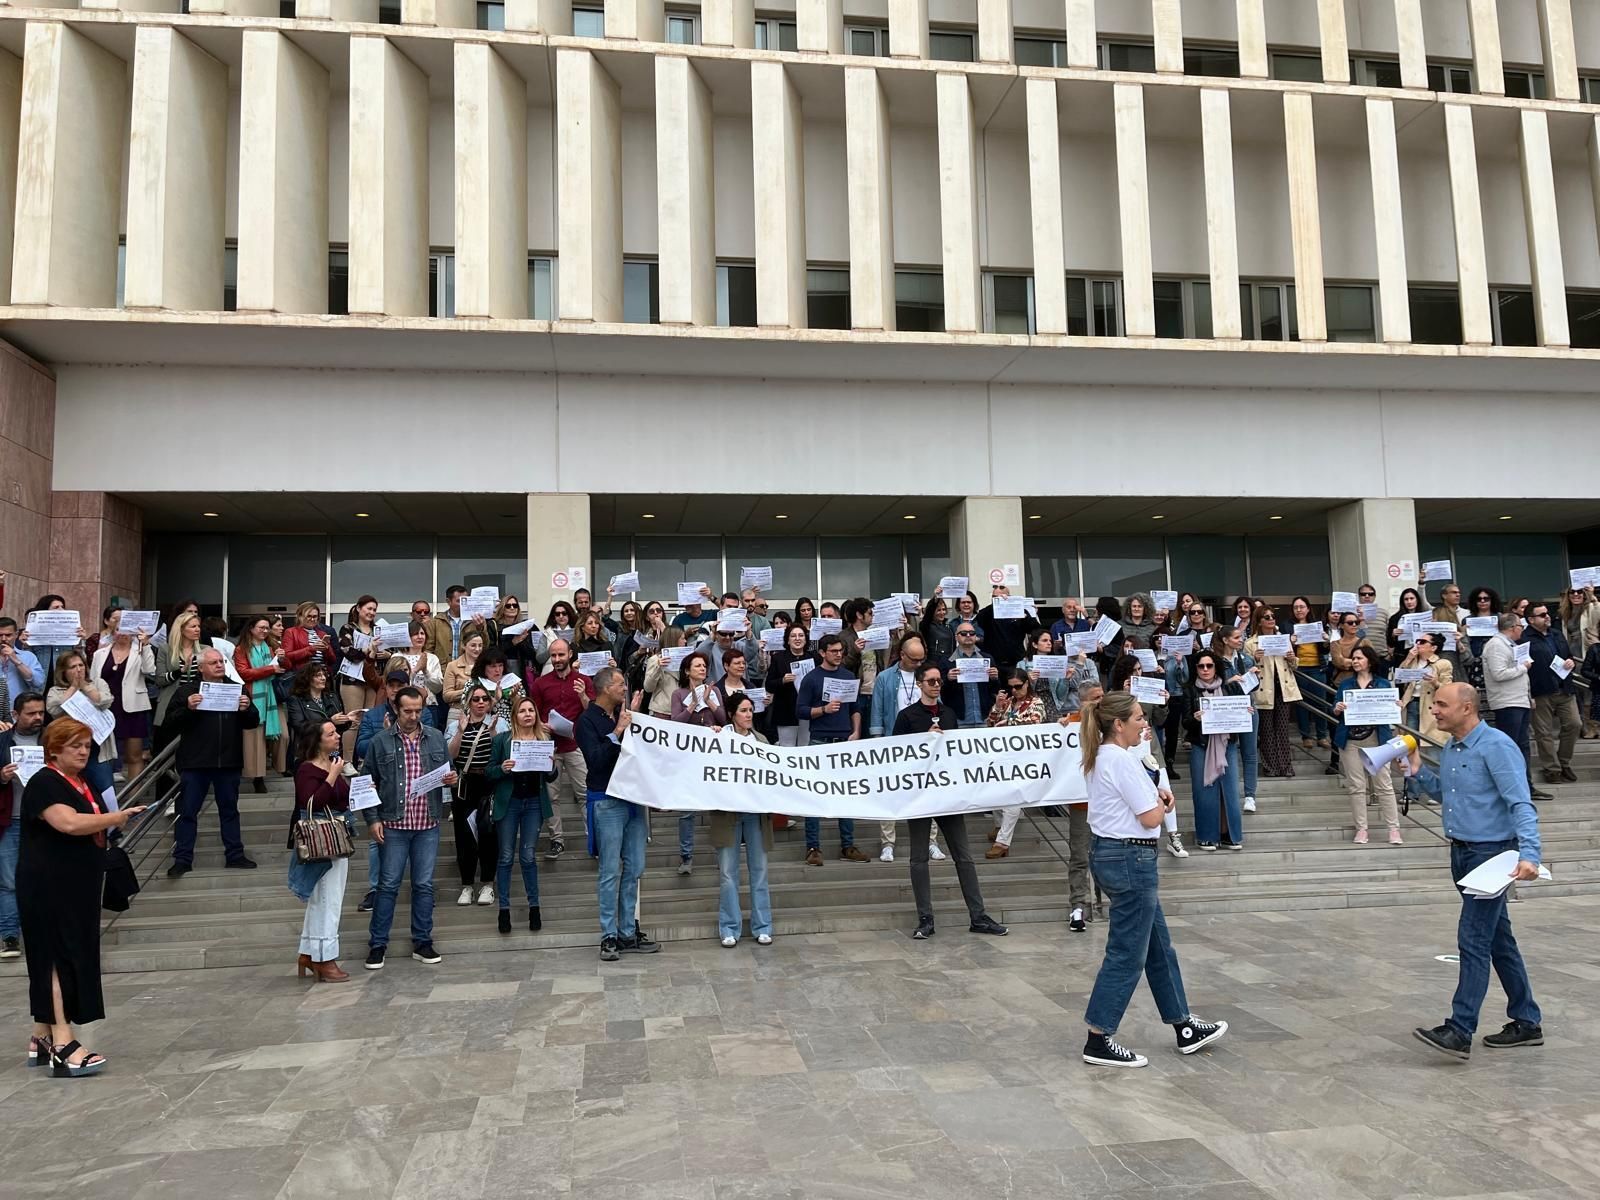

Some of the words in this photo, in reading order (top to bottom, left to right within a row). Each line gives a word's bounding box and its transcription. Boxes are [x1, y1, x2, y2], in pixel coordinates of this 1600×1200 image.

[630, 723, 669, 747] POR
[675, 733, 723, 754] UNA
[730, 738, 781, 764] LOEO
[787, 755, 820, 770] SIN
[946, 732, 1062, 757] FUNCIONES
[703, 766, 871, 795] RETRIBUCIONES
[876, 770, 958, 793] JUSTAS.
[963, 761, 1052, 784] MÁLAGA
